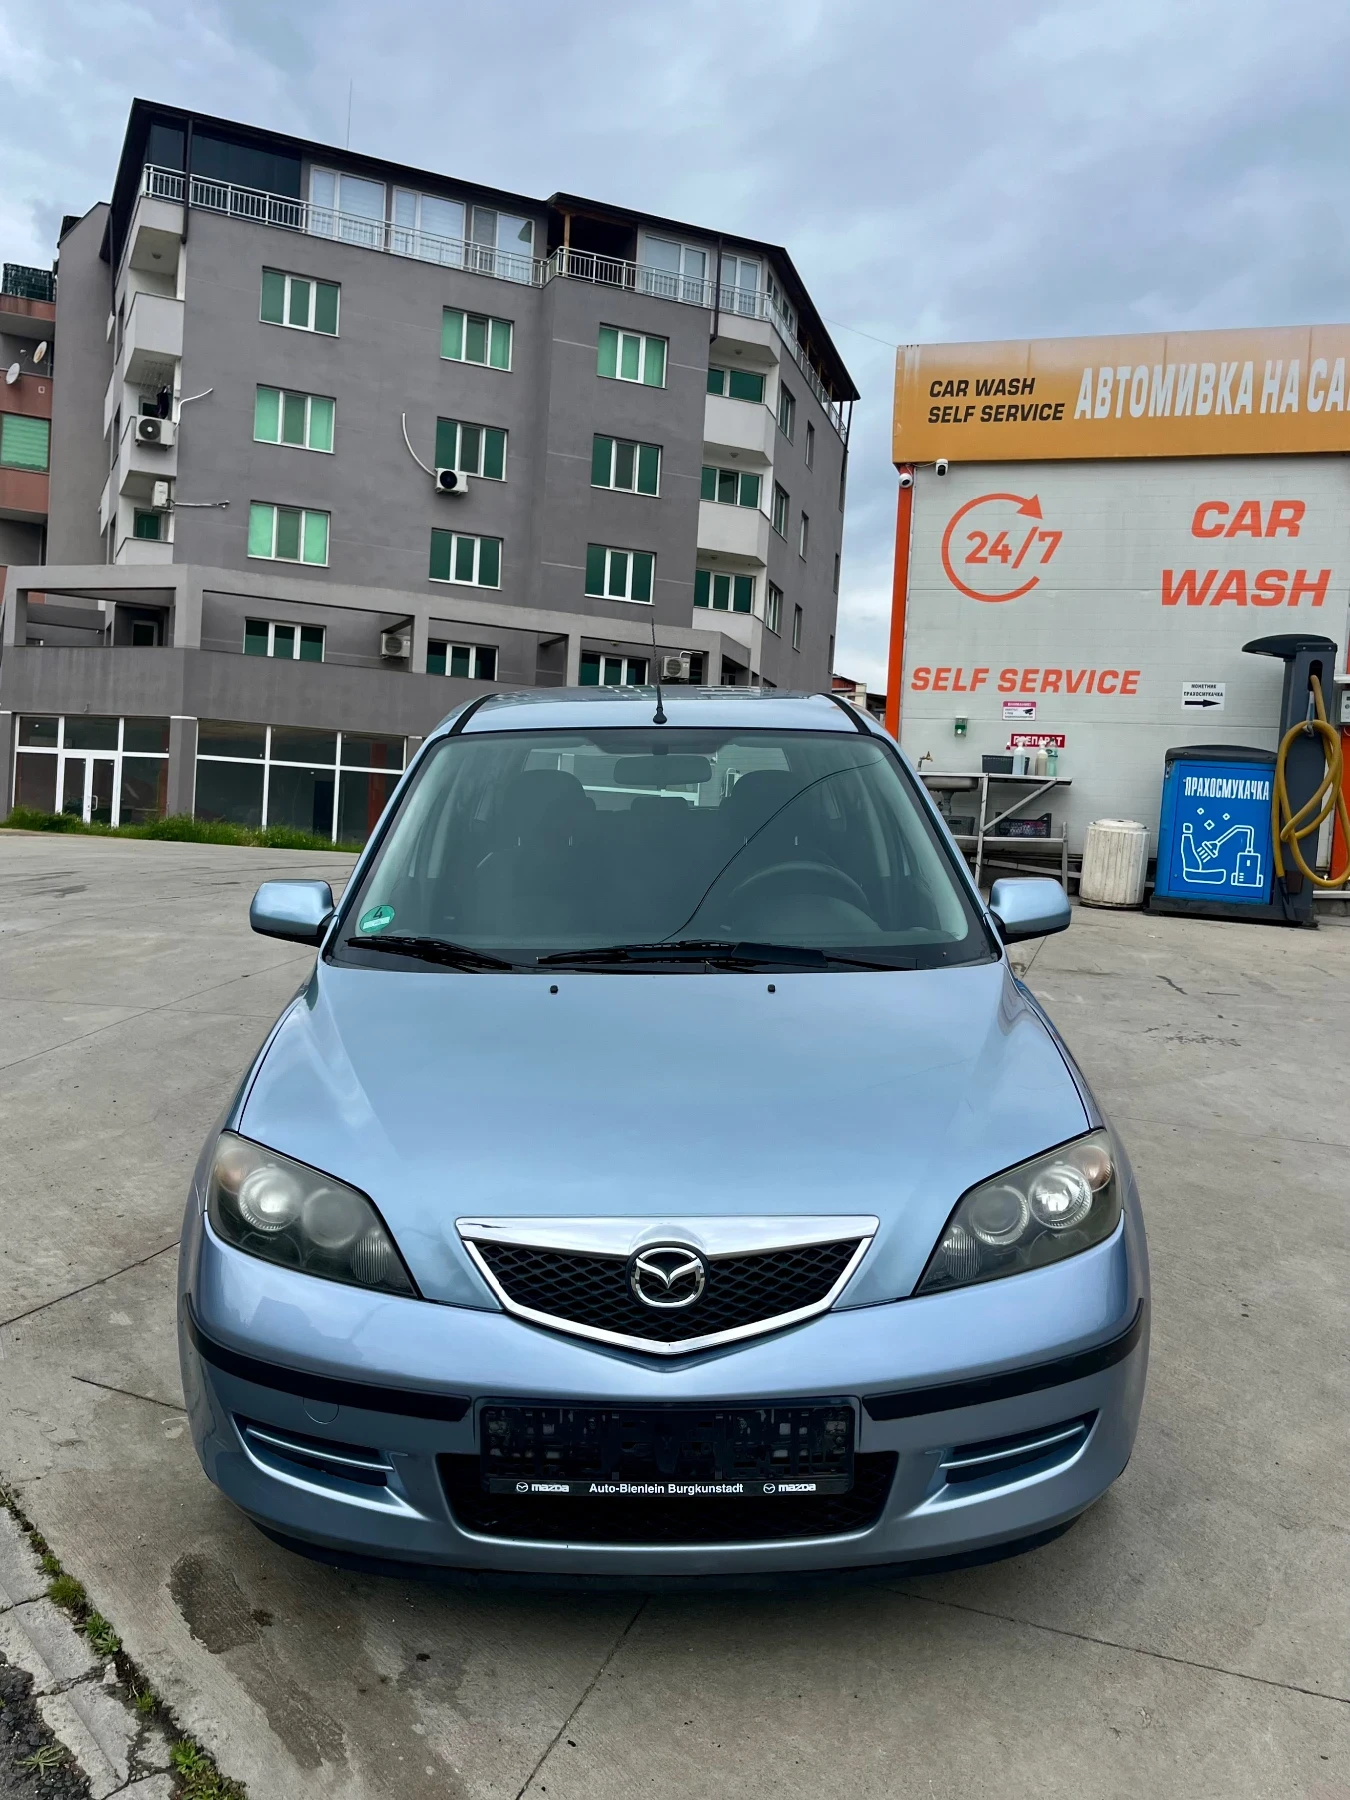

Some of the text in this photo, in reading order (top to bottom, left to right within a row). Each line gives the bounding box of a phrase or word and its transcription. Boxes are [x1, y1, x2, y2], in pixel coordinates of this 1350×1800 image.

[929, 378, 1035, 397] CAR WASH
[1073, 357, 1350, 419] АВТОМИВКА НА СА
[928, 403, 1065, 423] SELF SERVICE
[1191, 500, 1306, 538] CAR
[965, 526, 1063, 569] 24/7
[1161, 569, 1331, 607] WASH
[911, 667, 1141, 695] SELF SERVICE
[1013, 735, 1063, 746] ПЕПАРАТ
[1184, 777, 1270, 800] ПРАХОСМУКАЧКА
[373, 907, 383, 919] 4
[589, 1483, 665, 1493] Auto-Bienlein
[668, 1483, 744, 1495] Burgkunstadt
